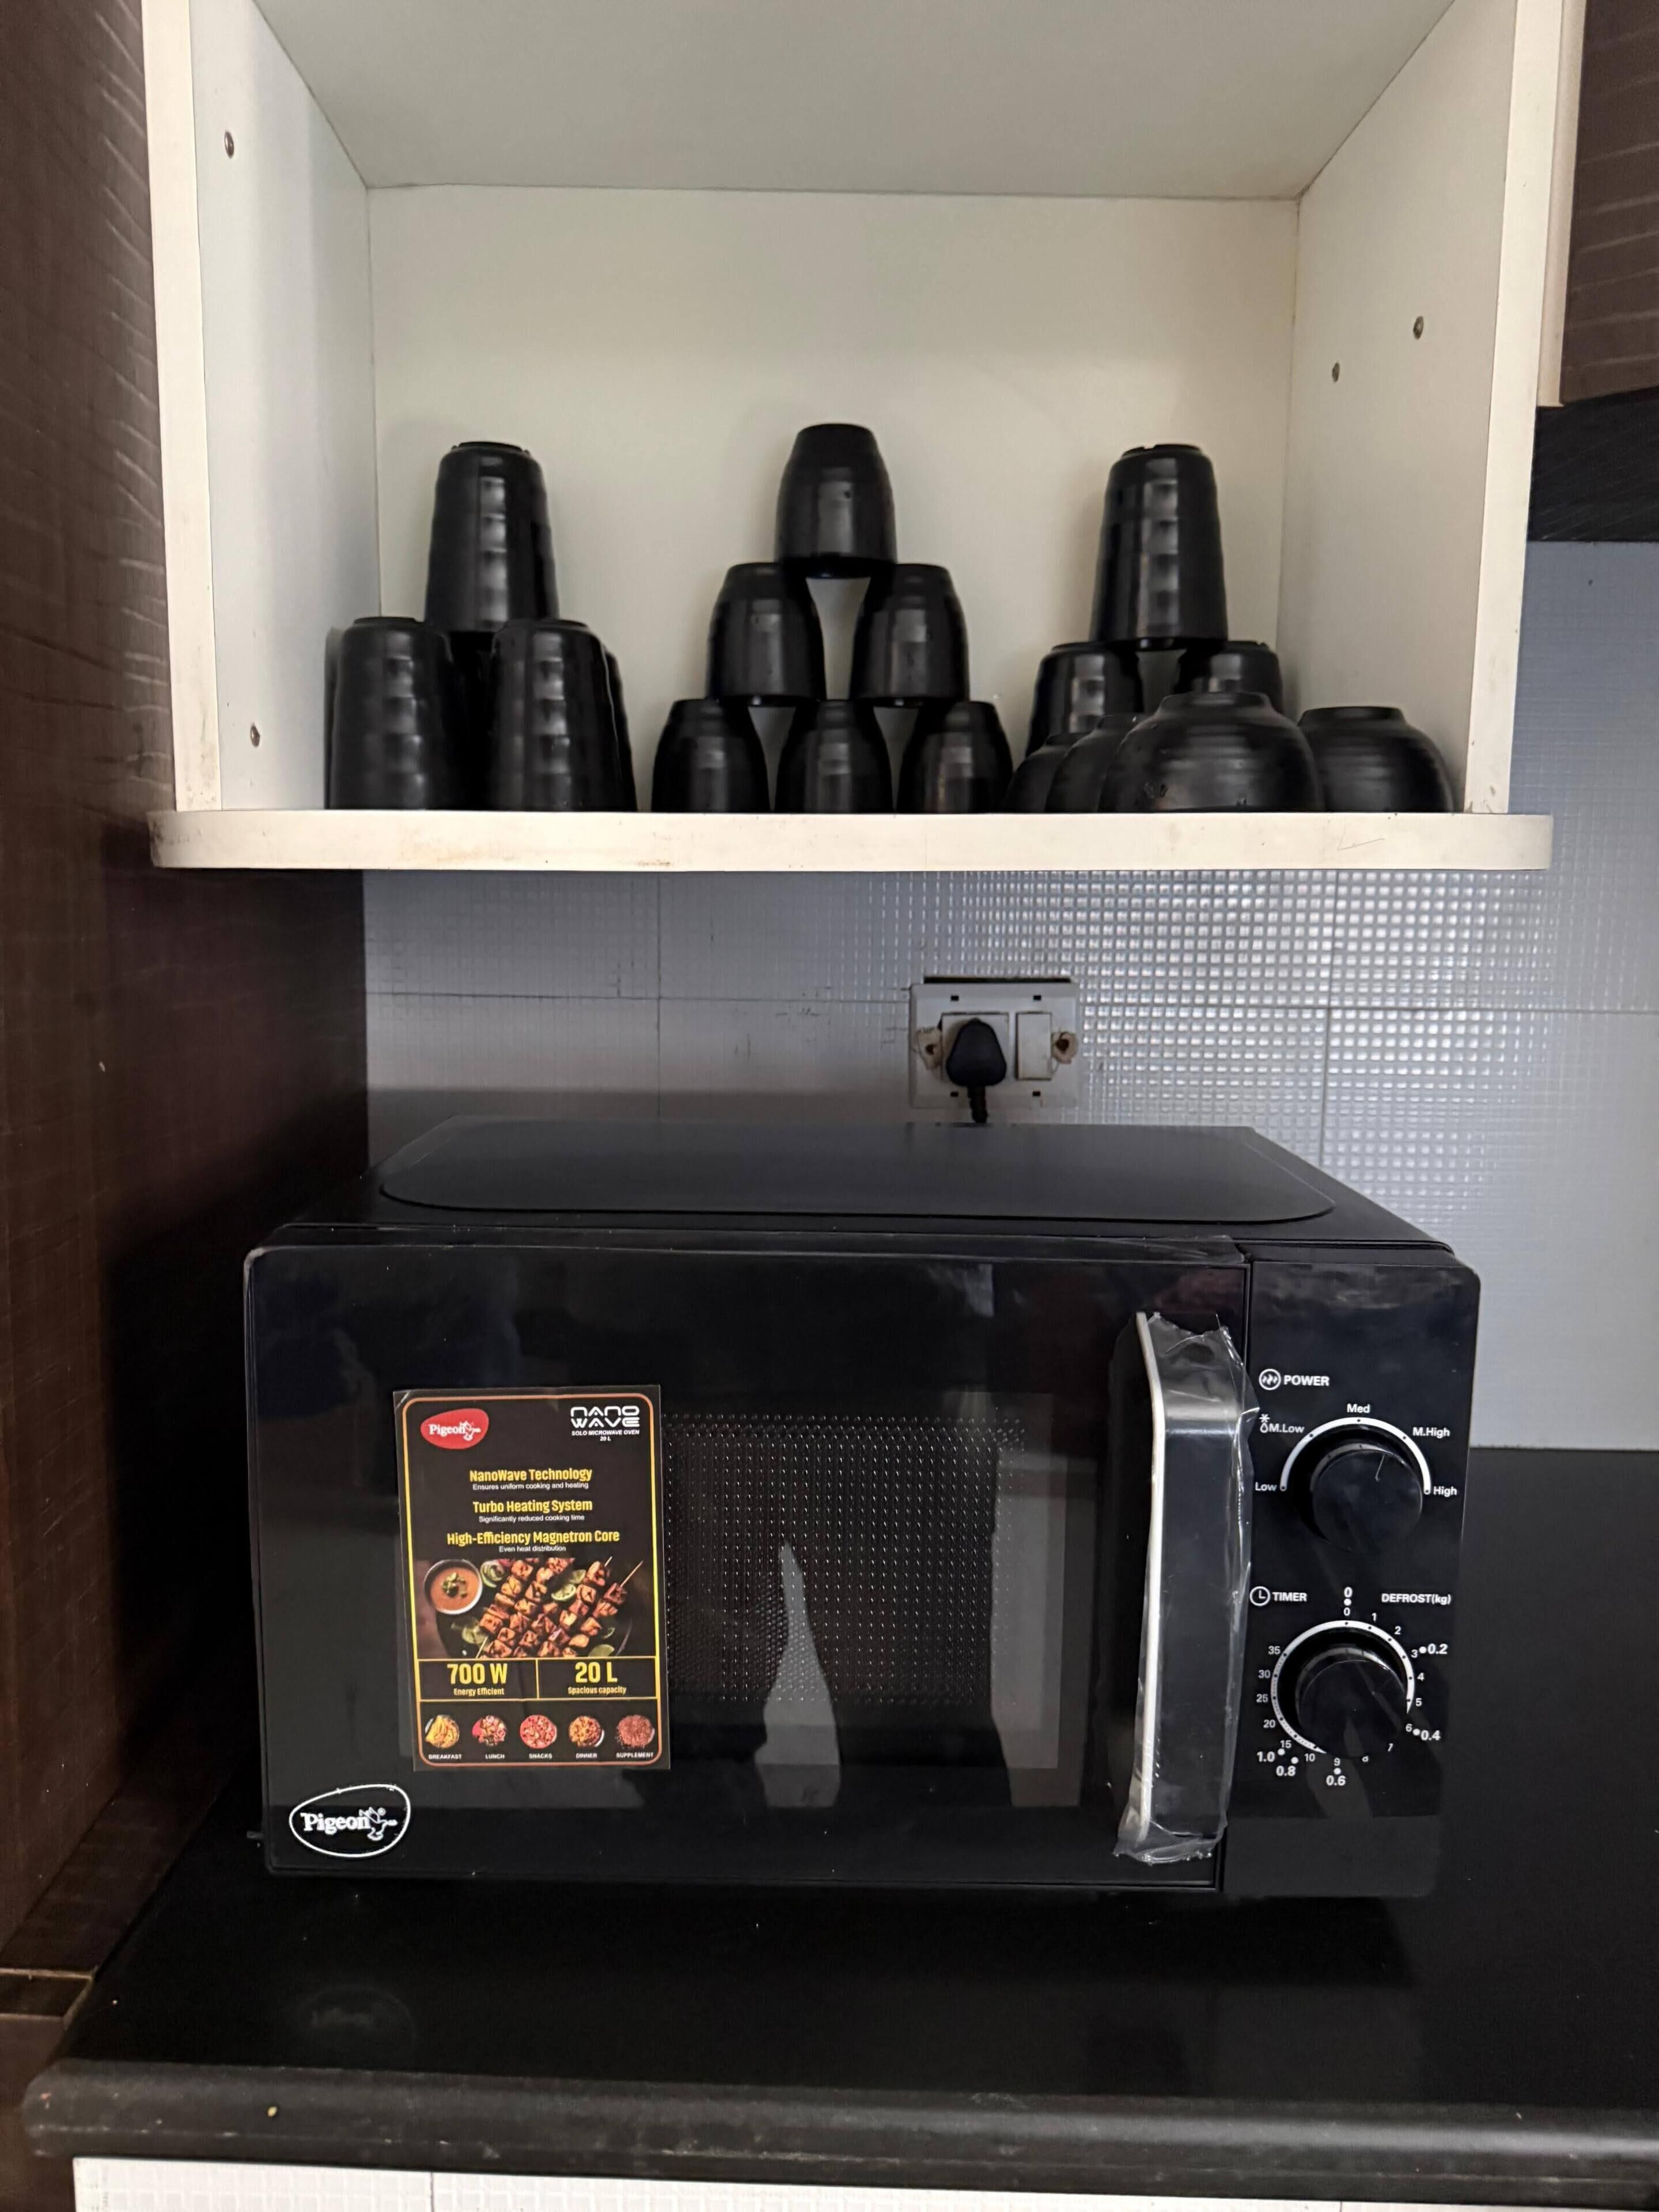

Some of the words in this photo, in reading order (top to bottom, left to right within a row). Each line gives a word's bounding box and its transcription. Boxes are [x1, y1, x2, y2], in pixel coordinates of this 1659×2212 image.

[1283, 1376, 1330, 1386] POWER
[570, 1406, 639, 1416] NANO
[1347, 1404, 1370, 1414] Med
[571, 1417, 640, 1428] WAVE
[429, 1424, 465, 1437] Pigeon
[1269, 1425, 1304, 1433] M.Low
[1412, 1427, 1450, 1438] M.High
[469, 1469, 527, 1482] NanoWave
[529, 1468, 592, 1482] Technology
[525, 1482, 550, 1490] cooking
[565, 1482, 589, 1490] heating
[1255, 1482, 1277, 1491] Low
[1433, 1487, 1457, 1497] High
[472, 1501, 504, 1513] Turbo
[506, 1499, 550, 1513] Heating
[551, 1500, 592, 1513] System
[479, 1515, 516, 1524] Significantly
[446, 1531, 531, 1546] High-Efficiency
[533, 1531, 592, 1544] Magnetron
[594, 1530, 620, 1542] Core
[1272, 1592, 1307, 1602] TIMER
[1344, 1587, 1353, 1597] 0
[1381, 1593, 1452, 1605] DEFROST(kg)
[1343, 1608, 1350, 1616] 0
[1372, 1613, 1377, 1621] 1
[1395, 1626, 1402, 1635] 2
[1268, 1646, 1281, 1654] 35
[1427, 1643, 1448, 1654] 0.2
[1411, 1650, 1418, 1658] 3
[447, 1663, 485, 1684] 700
[490, 1663, 508, 1684] W
[575, 1661, 601, 1683] 20
[606, 1661, 618, 1683] L
[1259, 1670, 1271, 1679] 30
[1417, 1673, 1425, 1681] 4
[453, 1688, 476, 1696] Energy
[477, 1687, 505, 1696] Efficient
[567, 1687, 597, 1695] Spacious
[599, 1686, 626, 1695] capacity
[1256, 1694, 1268, 1702] 25
[1416, 1698, 1422, 1706] 5
[1263, 1720, 1275, 1728] 20
[1406, 1724, 1412, 1732] 6
[1421, 1730, 1441, 1741] 0.4
[1280, 1740, 1291, 1748] 15
[1257, 1751, 1275, 1762] 1.0
[1304, 1753, 1316, 1762] 10
[1334, 1758, 1340, 1766] 9
[1276, 1766, 1296, 1777] 0.8
[1326, 1775, 1346, 1786] 0.6
[300, 1812, 372, 1835] Pigeon
